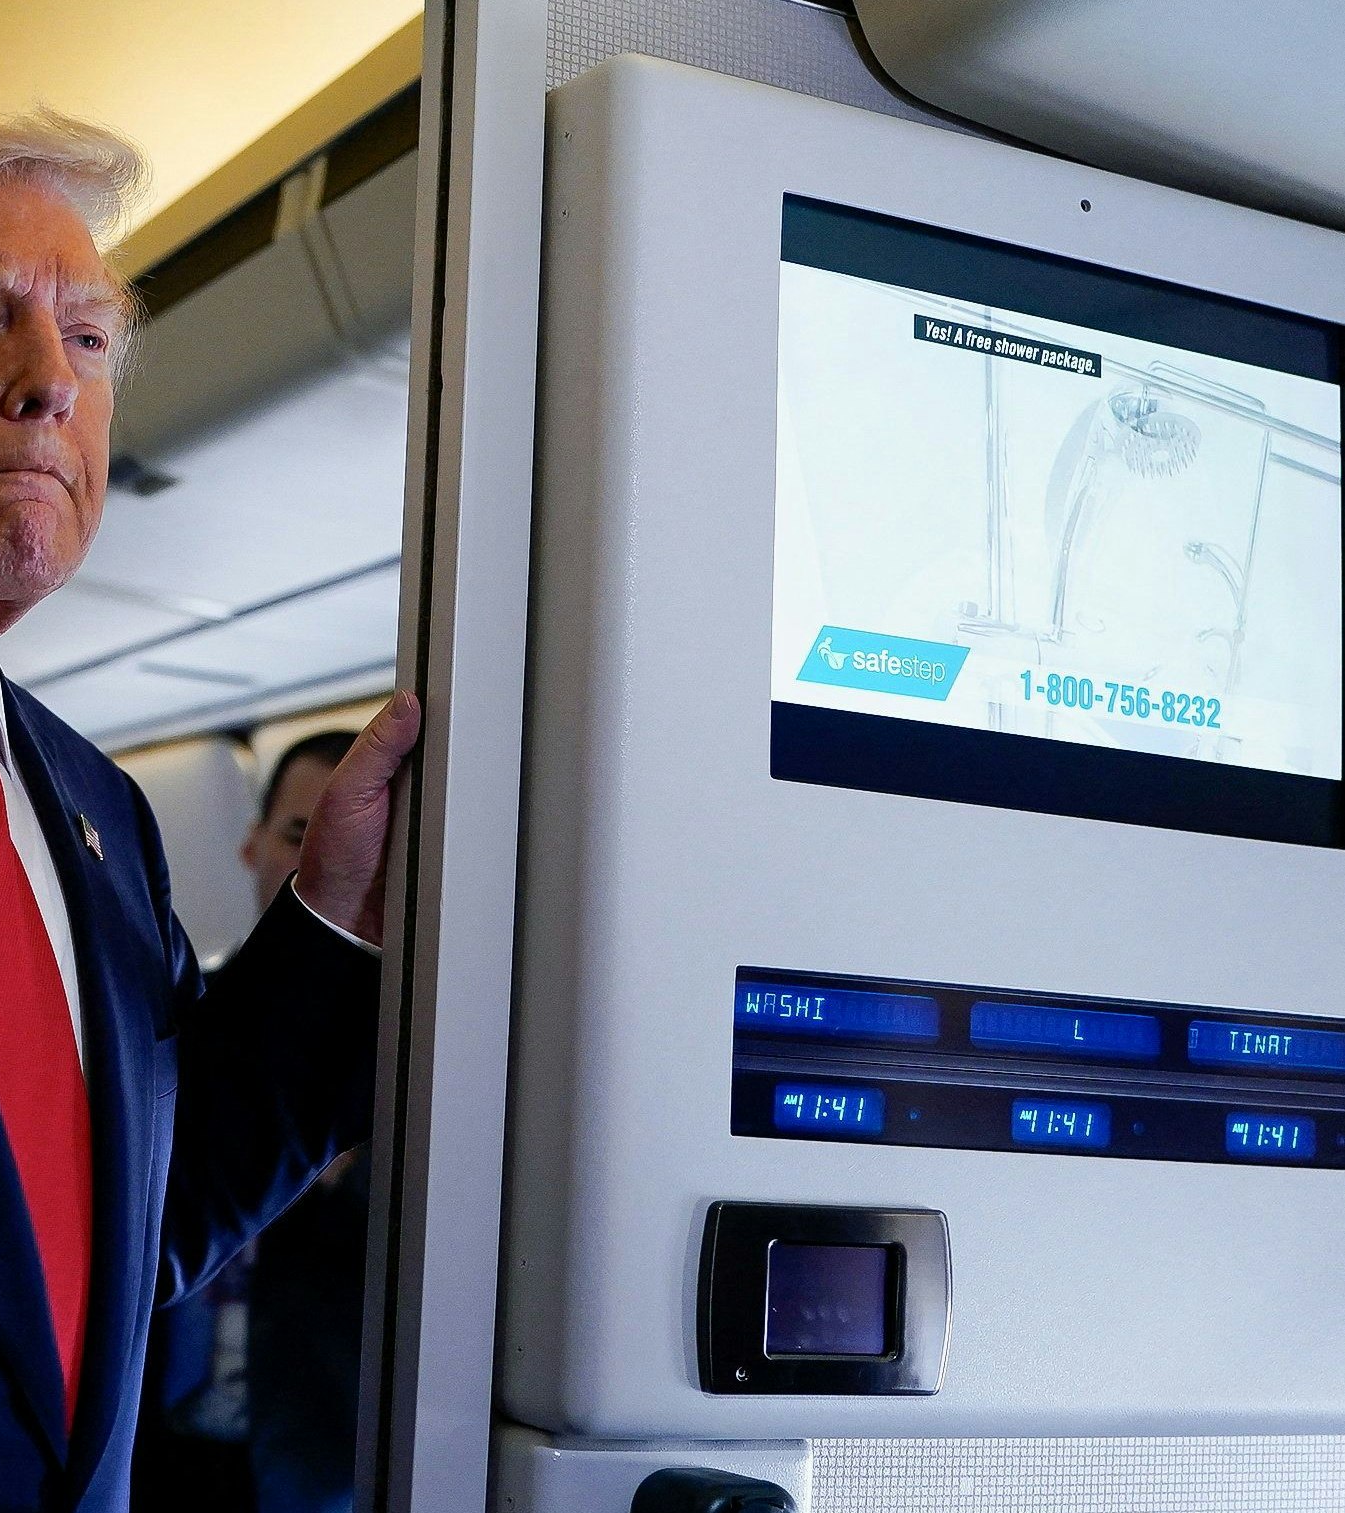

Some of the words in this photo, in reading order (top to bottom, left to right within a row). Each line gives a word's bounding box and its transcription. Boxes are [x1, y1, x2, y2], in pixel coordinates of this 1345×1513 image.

[924, 320, 952, 342] Yes!
[954, 327, 963, 345] A
[965, 329, 992, 351] free
[994, 337, 1039, 361] shower
[1041, 348, 1096, 374] package.
[852, 649, 946, 686] safestep
[1020, 669, 1221, 729] 1-800-756-8232
[746, 992, 825, 1021] WASHI
[1074, 1019, 1084, 1041] L
[1230, 1031, 1292, 1056] TINAT
